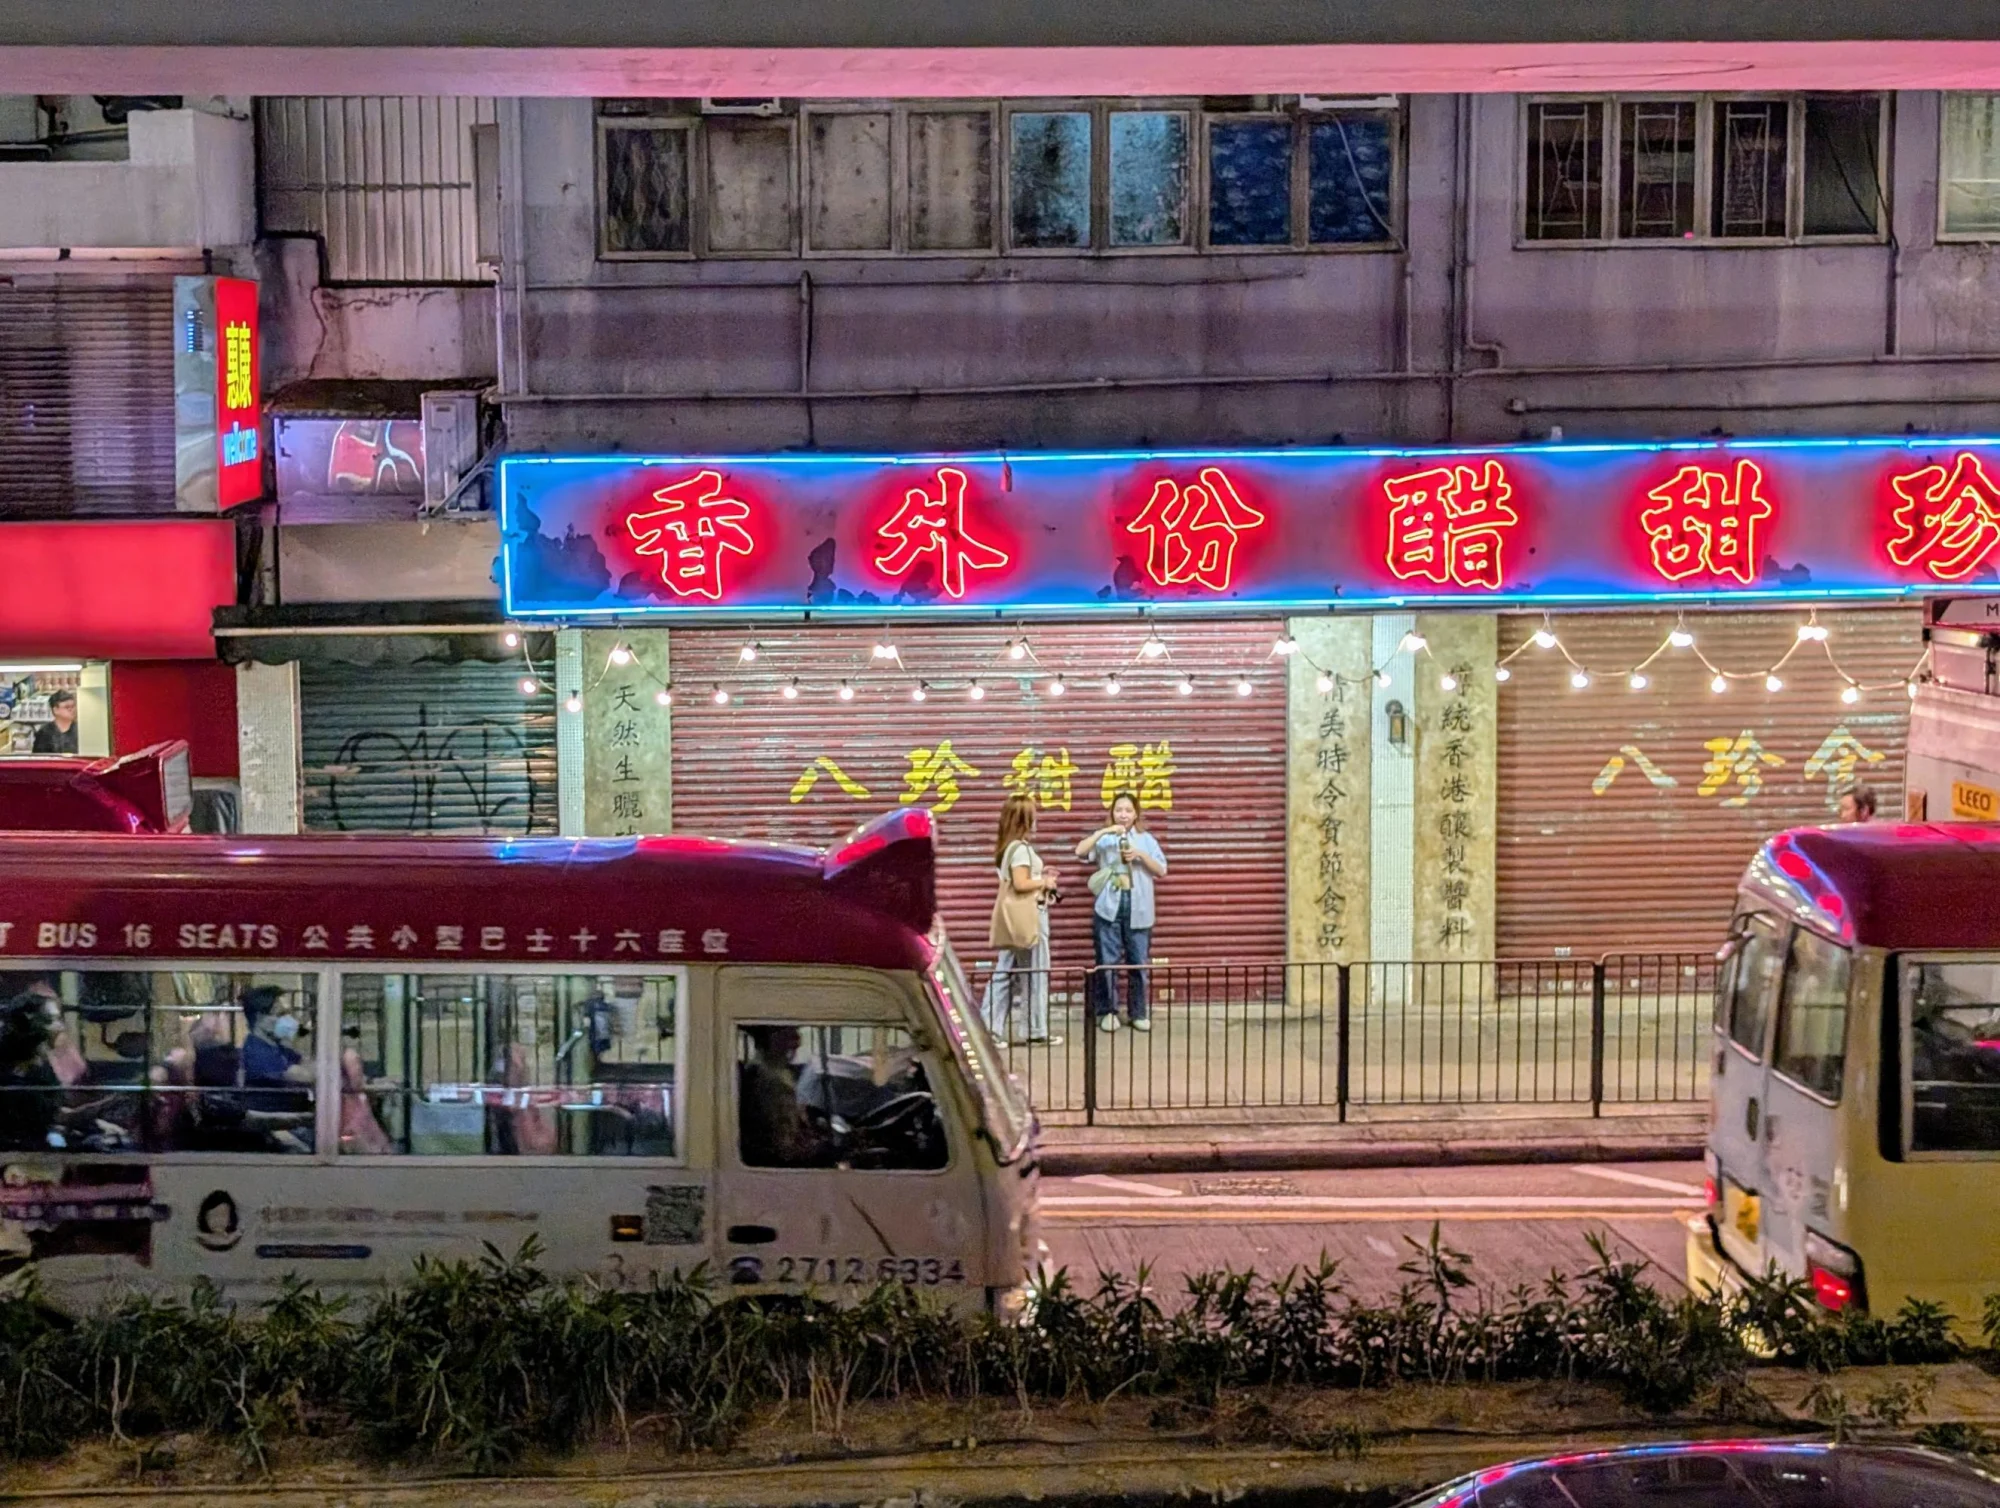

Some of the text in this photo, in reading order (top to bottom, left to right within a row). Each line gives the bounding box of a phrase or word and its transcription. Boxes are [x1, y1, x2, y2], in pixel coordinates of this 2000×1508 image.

[612, 684, 643, 836] 天然生曬
[37, 922, 98, 948] BUS
[123, 923, 152, 949] 16
[178, 923, 279, 950] SEATS
